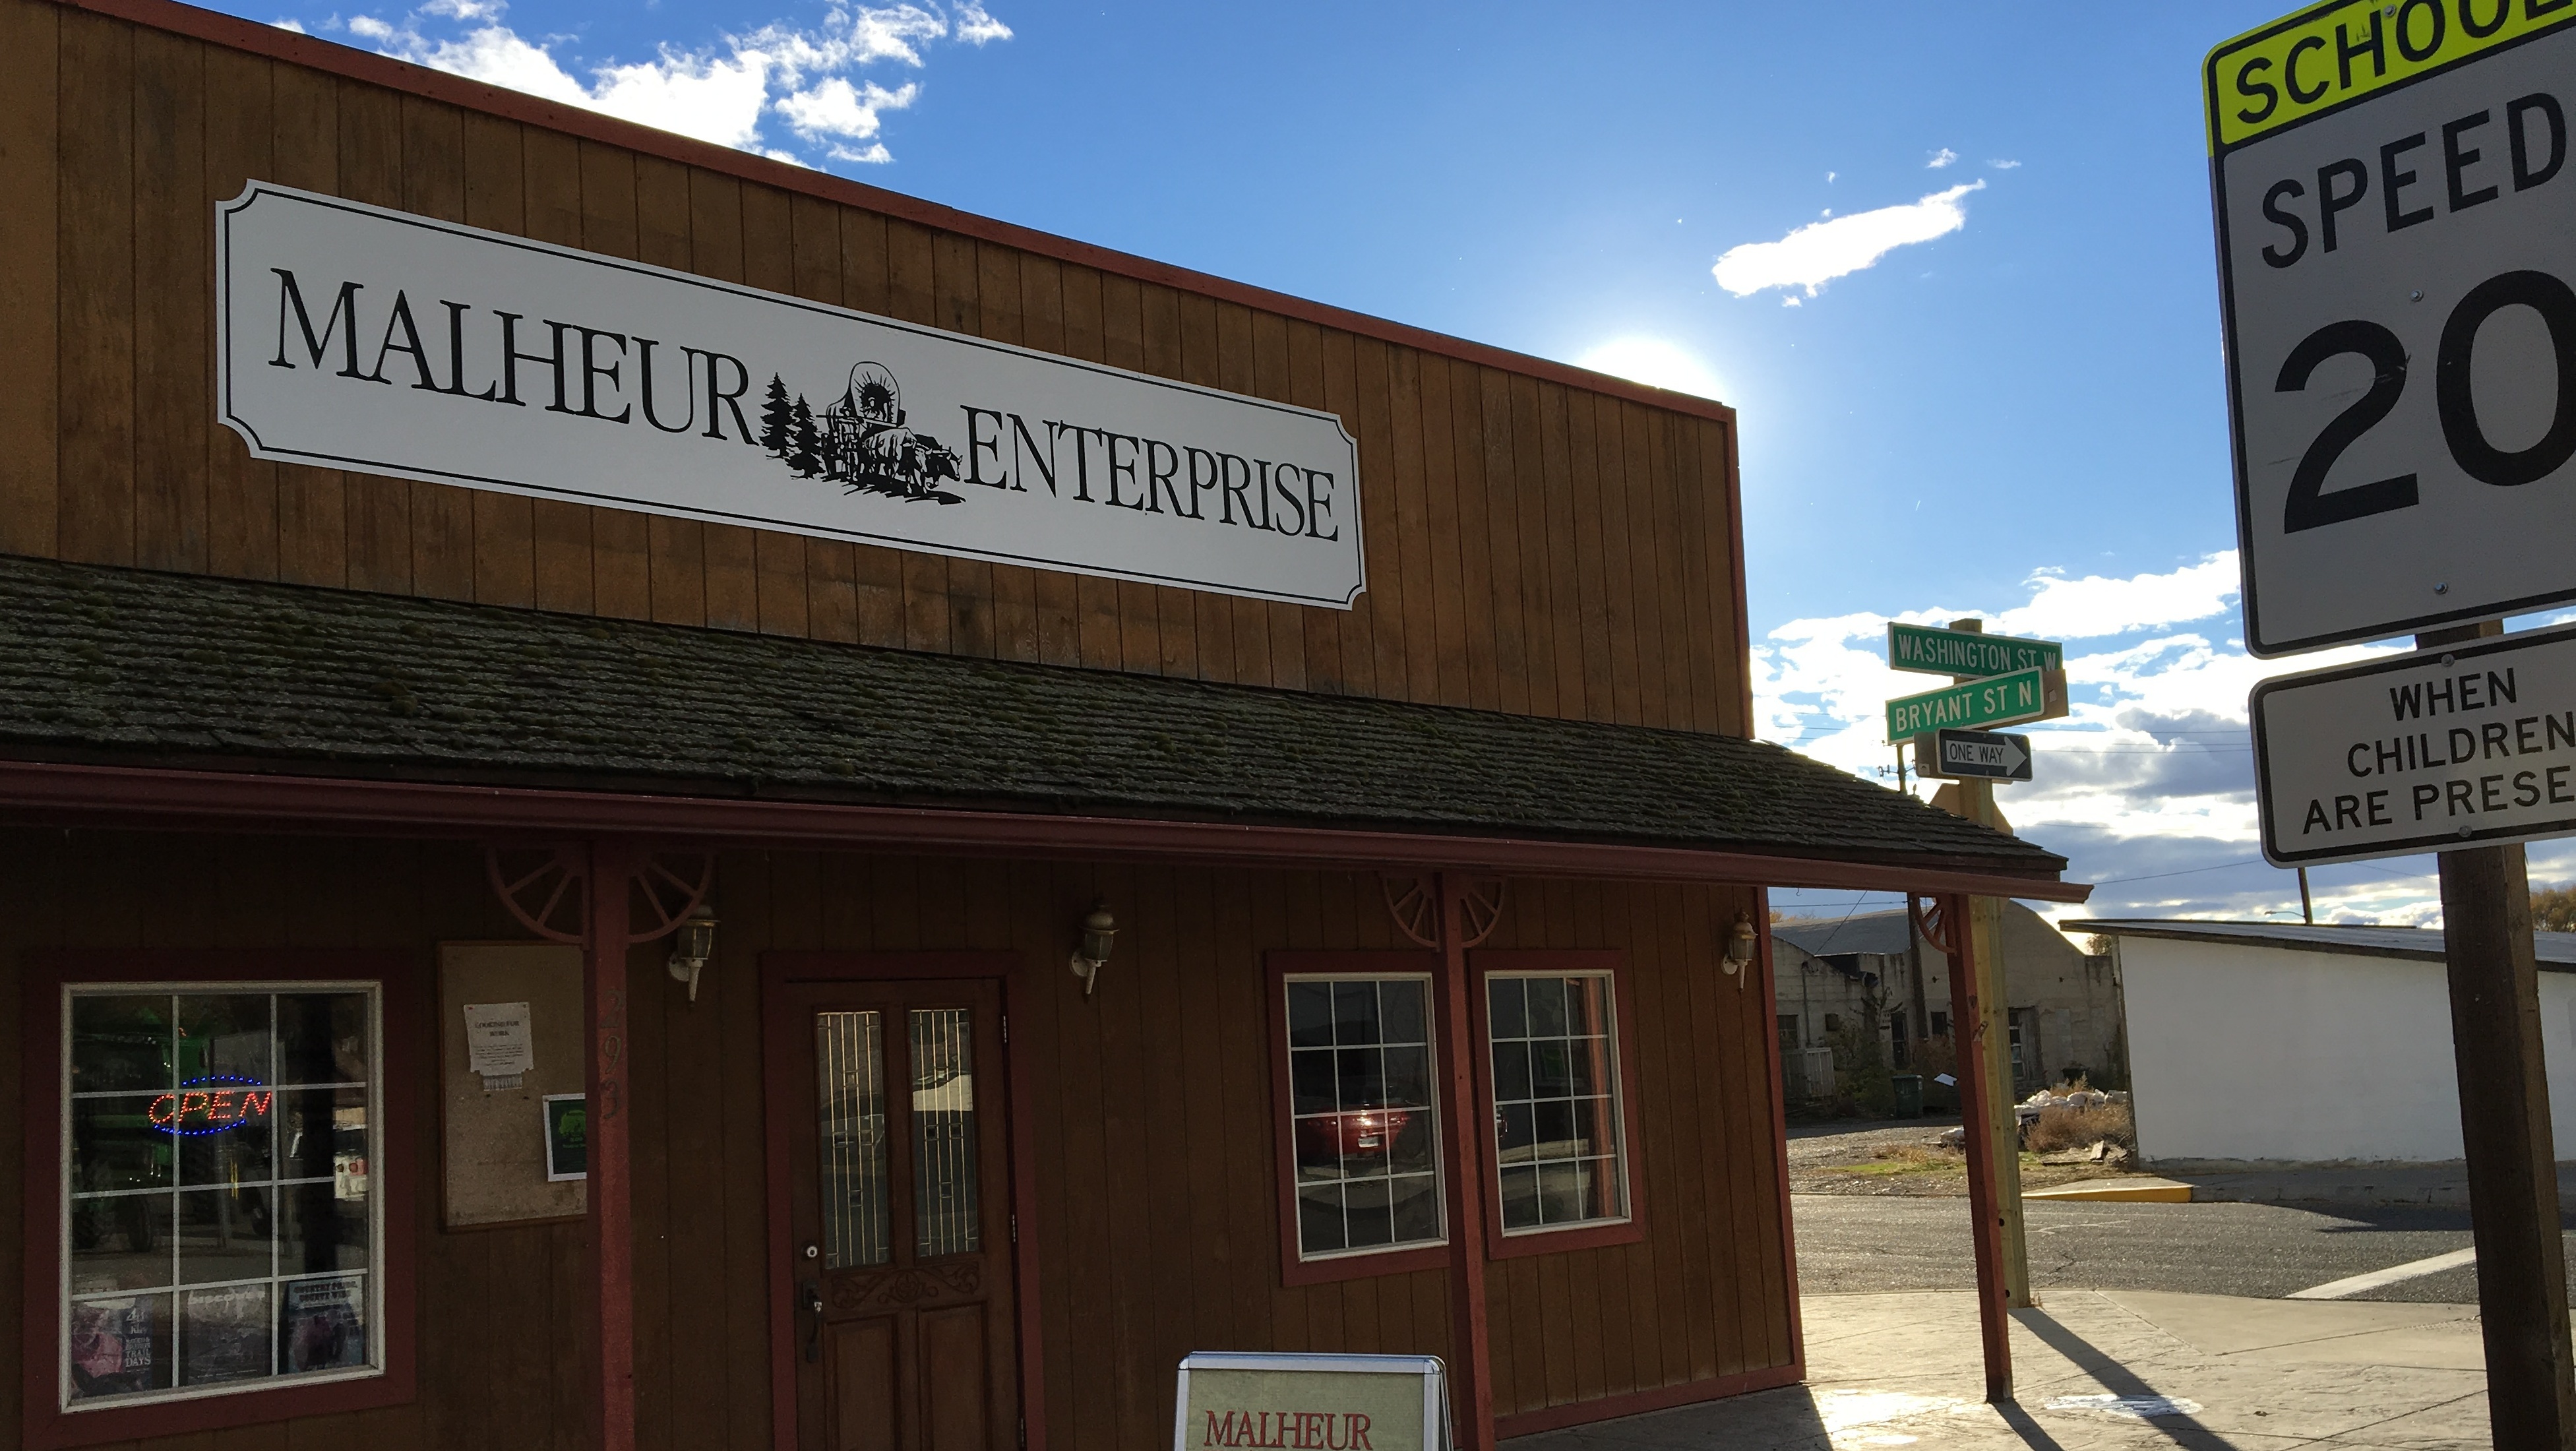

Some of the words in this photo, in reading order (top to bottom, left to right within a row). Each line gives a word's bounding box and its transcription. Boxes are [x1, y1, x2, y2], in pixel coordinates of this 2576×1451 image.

[2262, 92, 2567, 268] SPEED
[268, 267, 760, 447] MALHEUR
[960, 404, 1339, 542] ENTERPRISE
[2275, 270, 2576, 534] 20
[1898, 634, 2011, 671] WASHINGTON
[2017, 648, 2037, 670] ST
[2044, 652, 2056, 671] W
[1896, 693, 1973, 732] BRYANT
[1984, 685, 2008, 714] ST
[2019, 680, 2032, 707] N
[2390, 667, 2517, 721] WHEN
[1949, 743, 1973, 761] ONE
[1979, 746, 2004, 764] WAY
[2347, 711, 2576, 778] CHILDREN
[2302, 790, 2393, 834] ARE
[2412, 765, 2575, 820] PRESE
[148, 1091, 272, 1123] OPEN
[1204, 1410, 1373, 1450] MALHEUR
